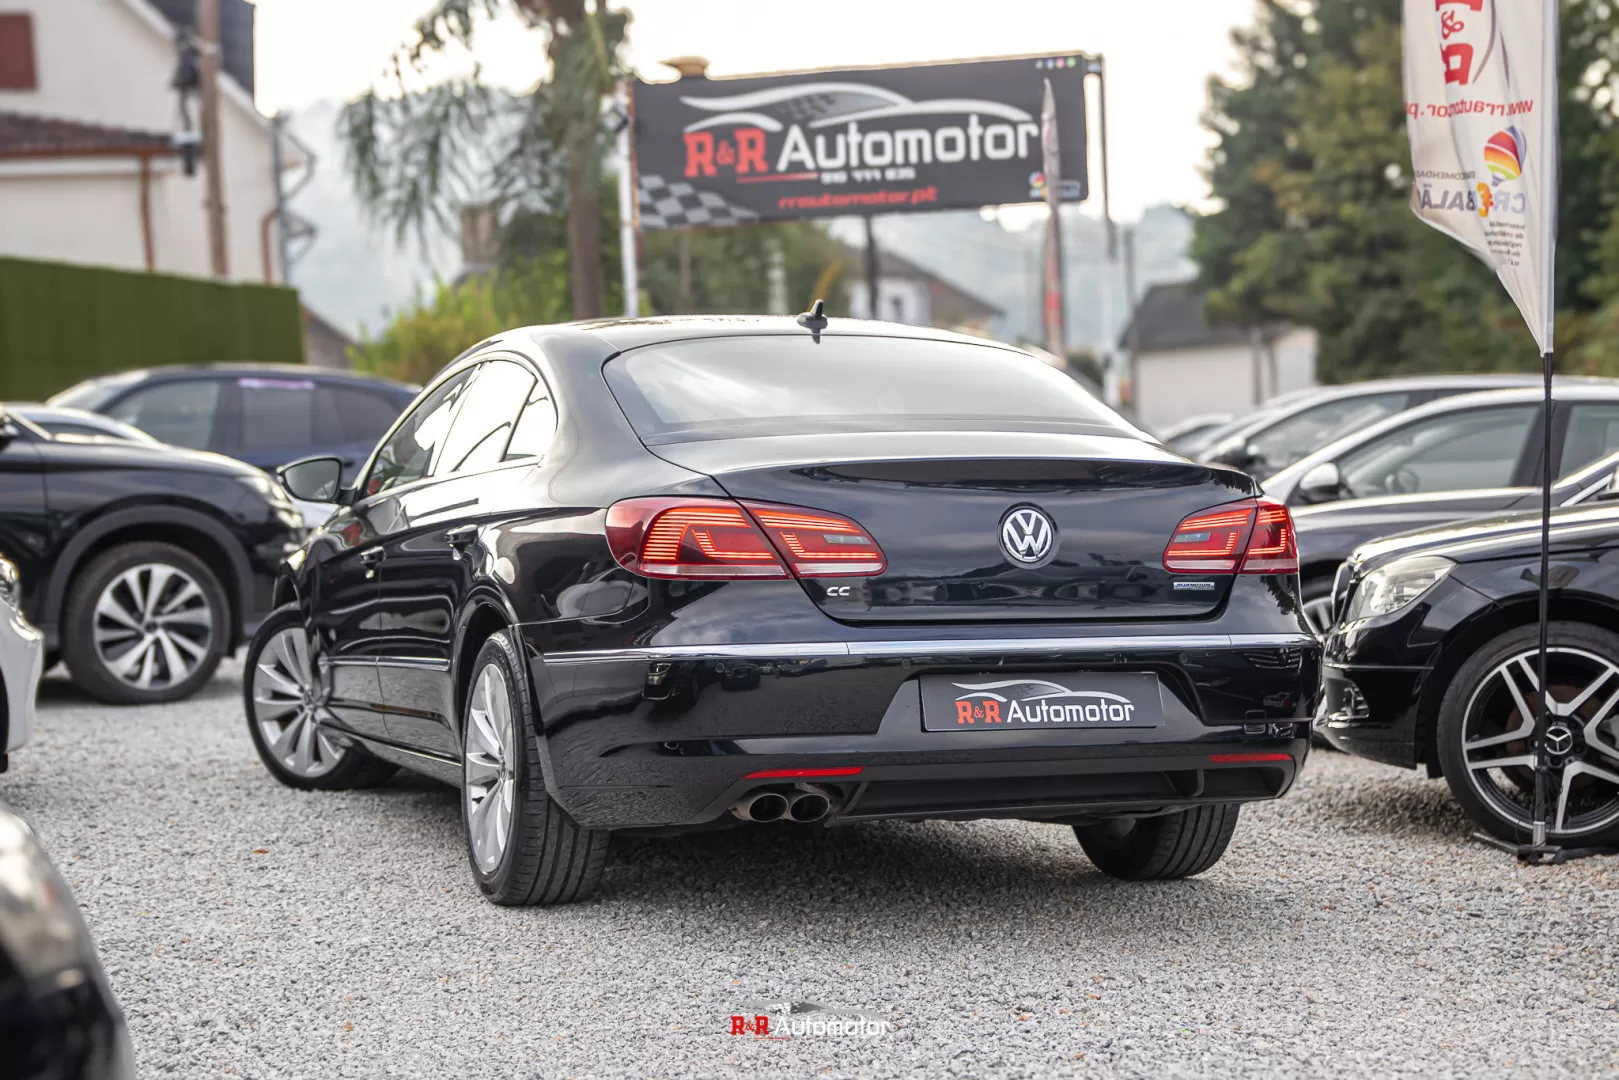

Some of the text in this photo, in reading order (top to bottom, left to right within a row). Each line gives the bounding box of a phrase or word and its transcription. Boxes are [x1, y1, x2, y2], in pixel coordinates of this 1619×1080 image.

[683, 113, 1040, 178] R&R Automotor
[826, 586, 851, 597] CC
[955, 698, 1135, 725] R&R Automotor
